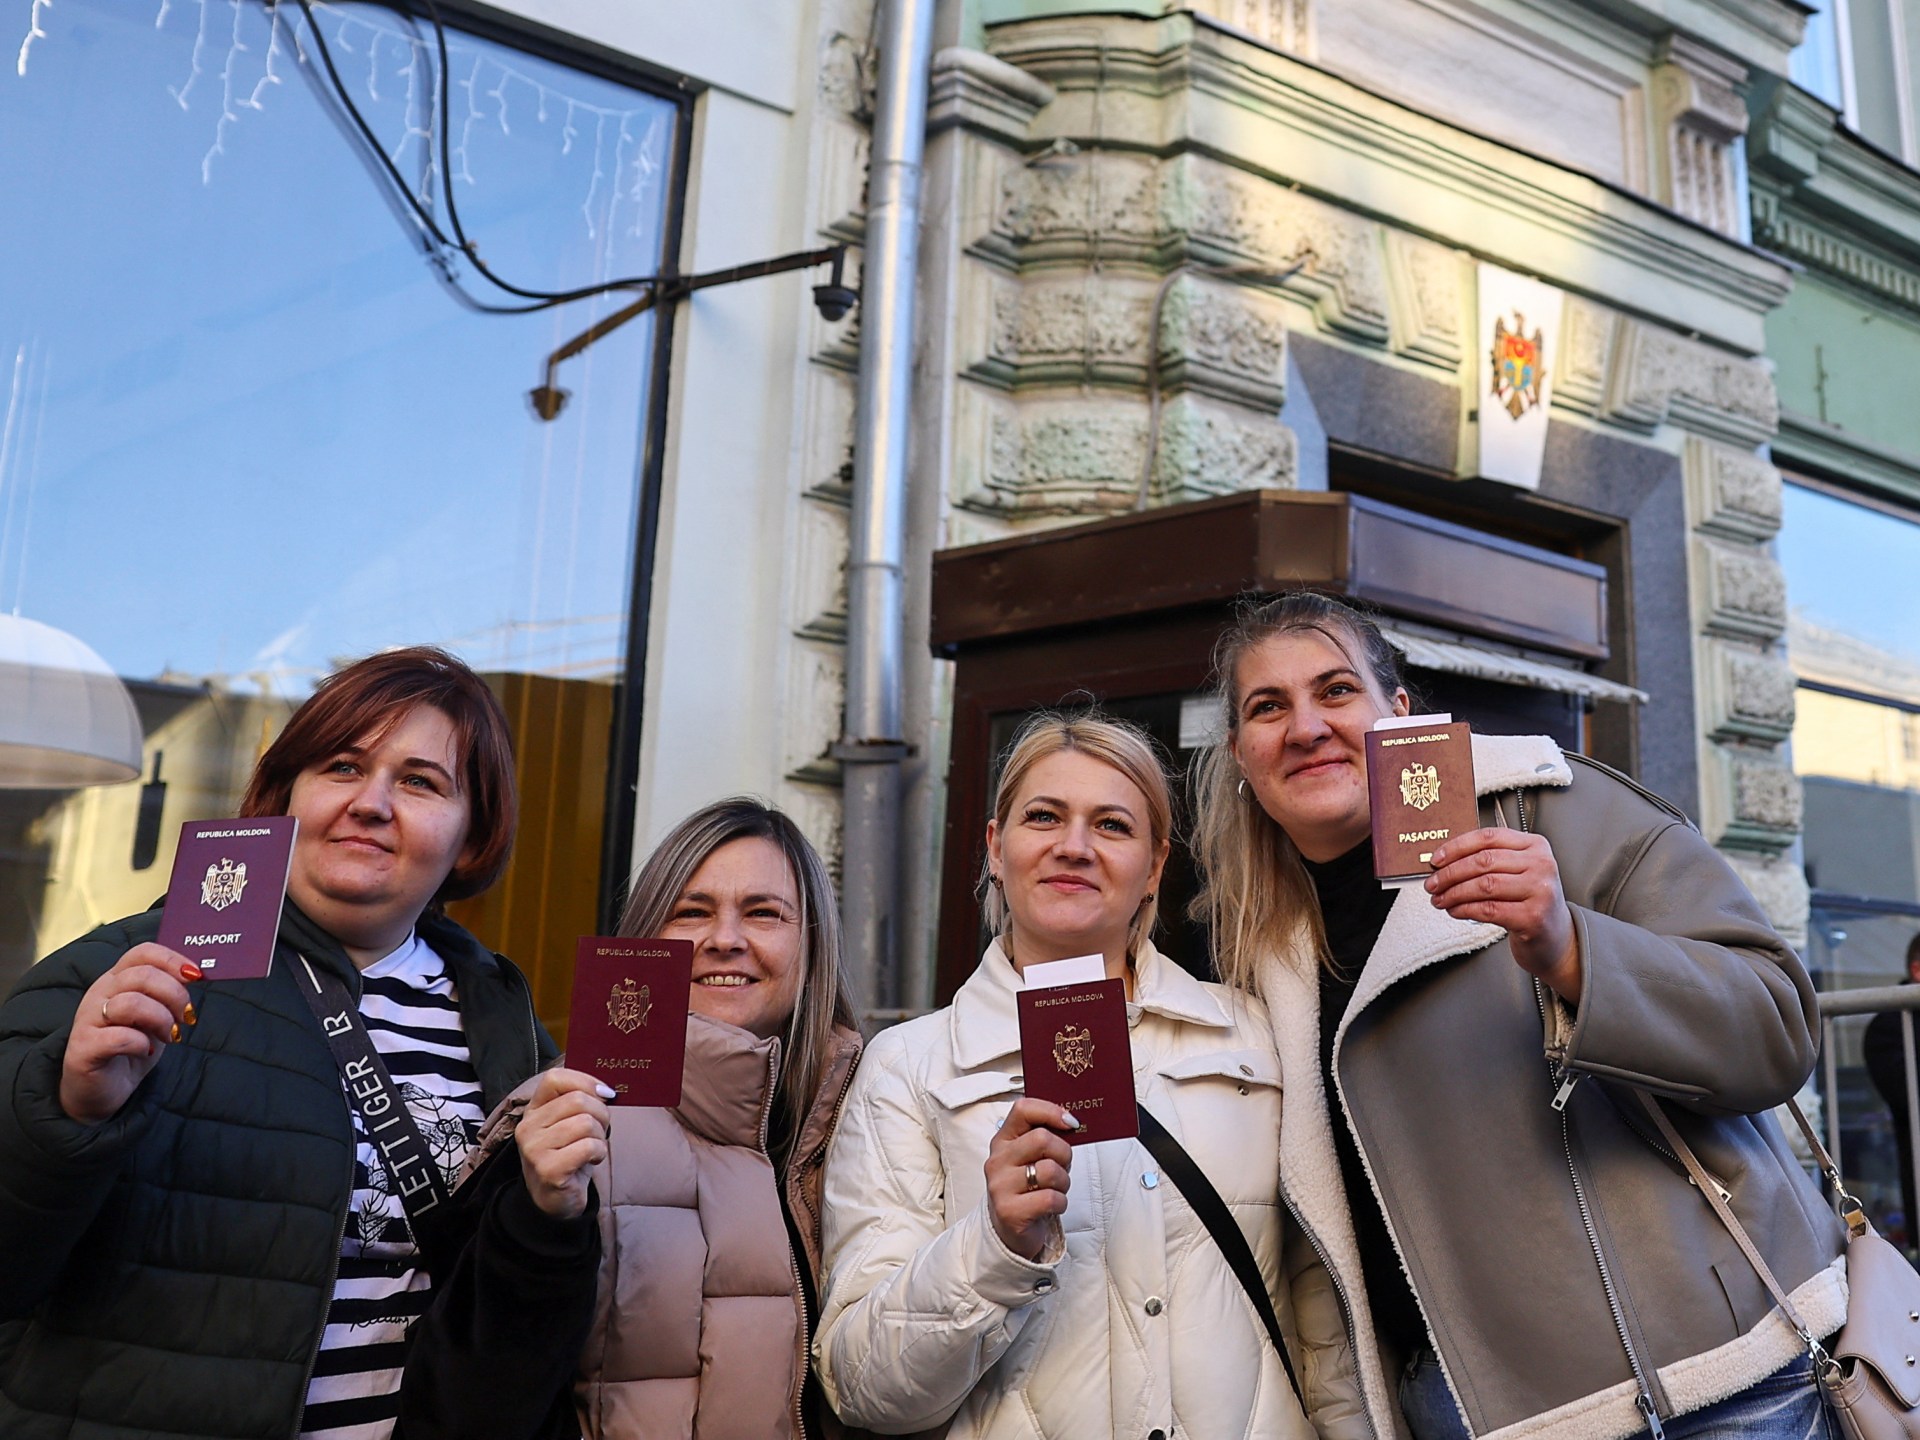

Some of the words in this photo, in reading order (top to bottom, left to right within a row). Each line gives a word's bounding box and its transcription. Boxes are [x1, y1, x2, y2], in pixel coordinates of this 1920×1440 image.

[1382, 737, 1416, 747] REPUBLICA
[1418, 733, 1450, 743] MOLDOVA
[196, 830, 234, 839] REPUBLICA
[236, 828, 271, 837] MOLDOVA
[1399, 829, 1450, 843] PAȘAPORT
[184, 933, 242, 947] PAȘAPORT
[596, 948, 635, 957] REPUBLICA
[636, 949, 671, 958] MOLDOVA
[1034, 997, 1070, 1008] REPUBLICA
[1071, 993, 1104, 1003] MOLDOVA
